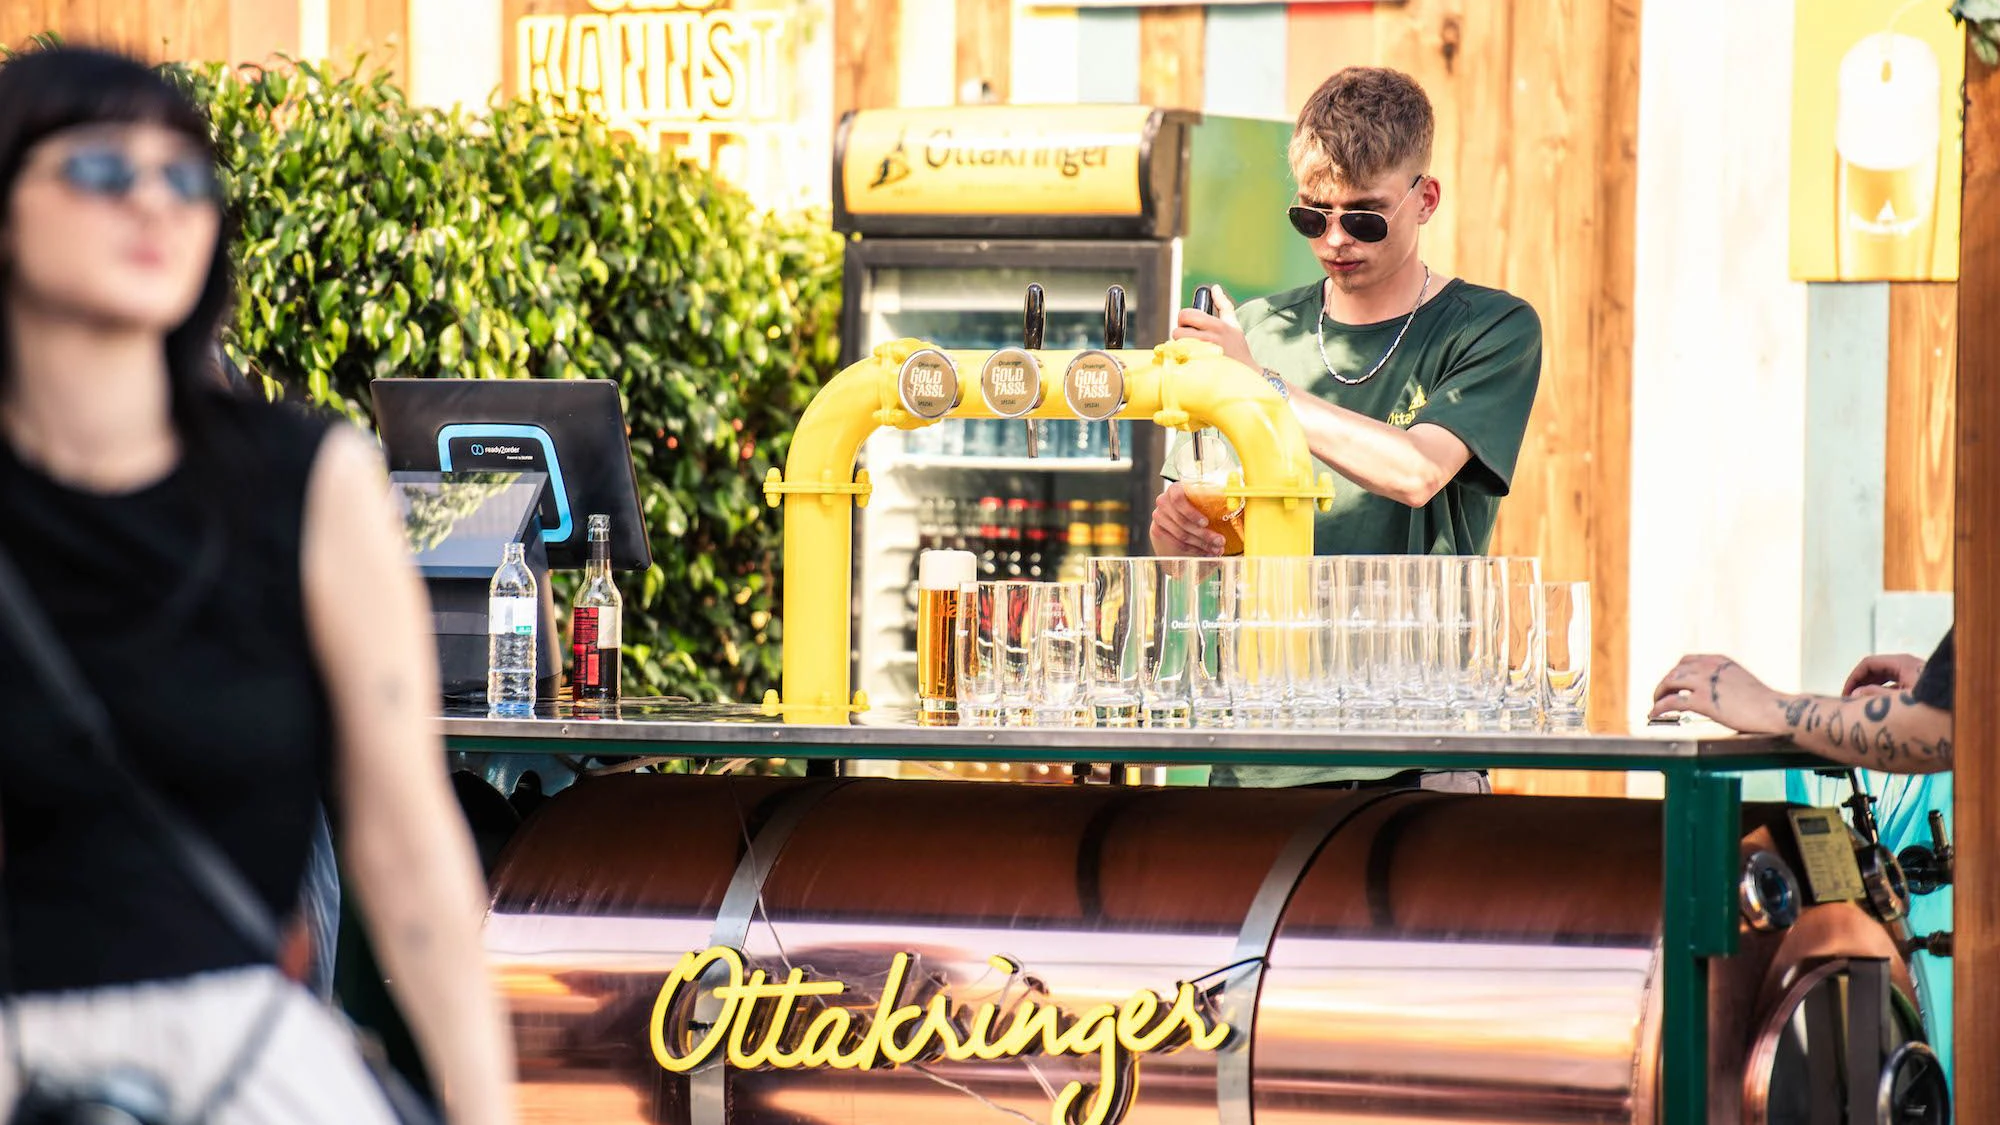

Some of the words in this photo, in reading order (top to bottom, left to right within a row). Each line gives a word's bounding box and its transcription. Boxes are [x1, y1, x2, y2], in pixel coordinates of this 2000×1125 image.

[516, 12, 784, 120] KANNST
[910, 367, 943, 385] GOLD
[991, 366, 1024, 384] GOLD
[1075, 369, 1108, 387] GOLD
[912, 384, 945, 398] FASSL
[994, 382, 1028, 397] FASSL
[1078, 384, 1112, 400] FASSL
[484, 446, 520, 454] ready2order
[650, 945, 1231, 1125] Ottakringer
